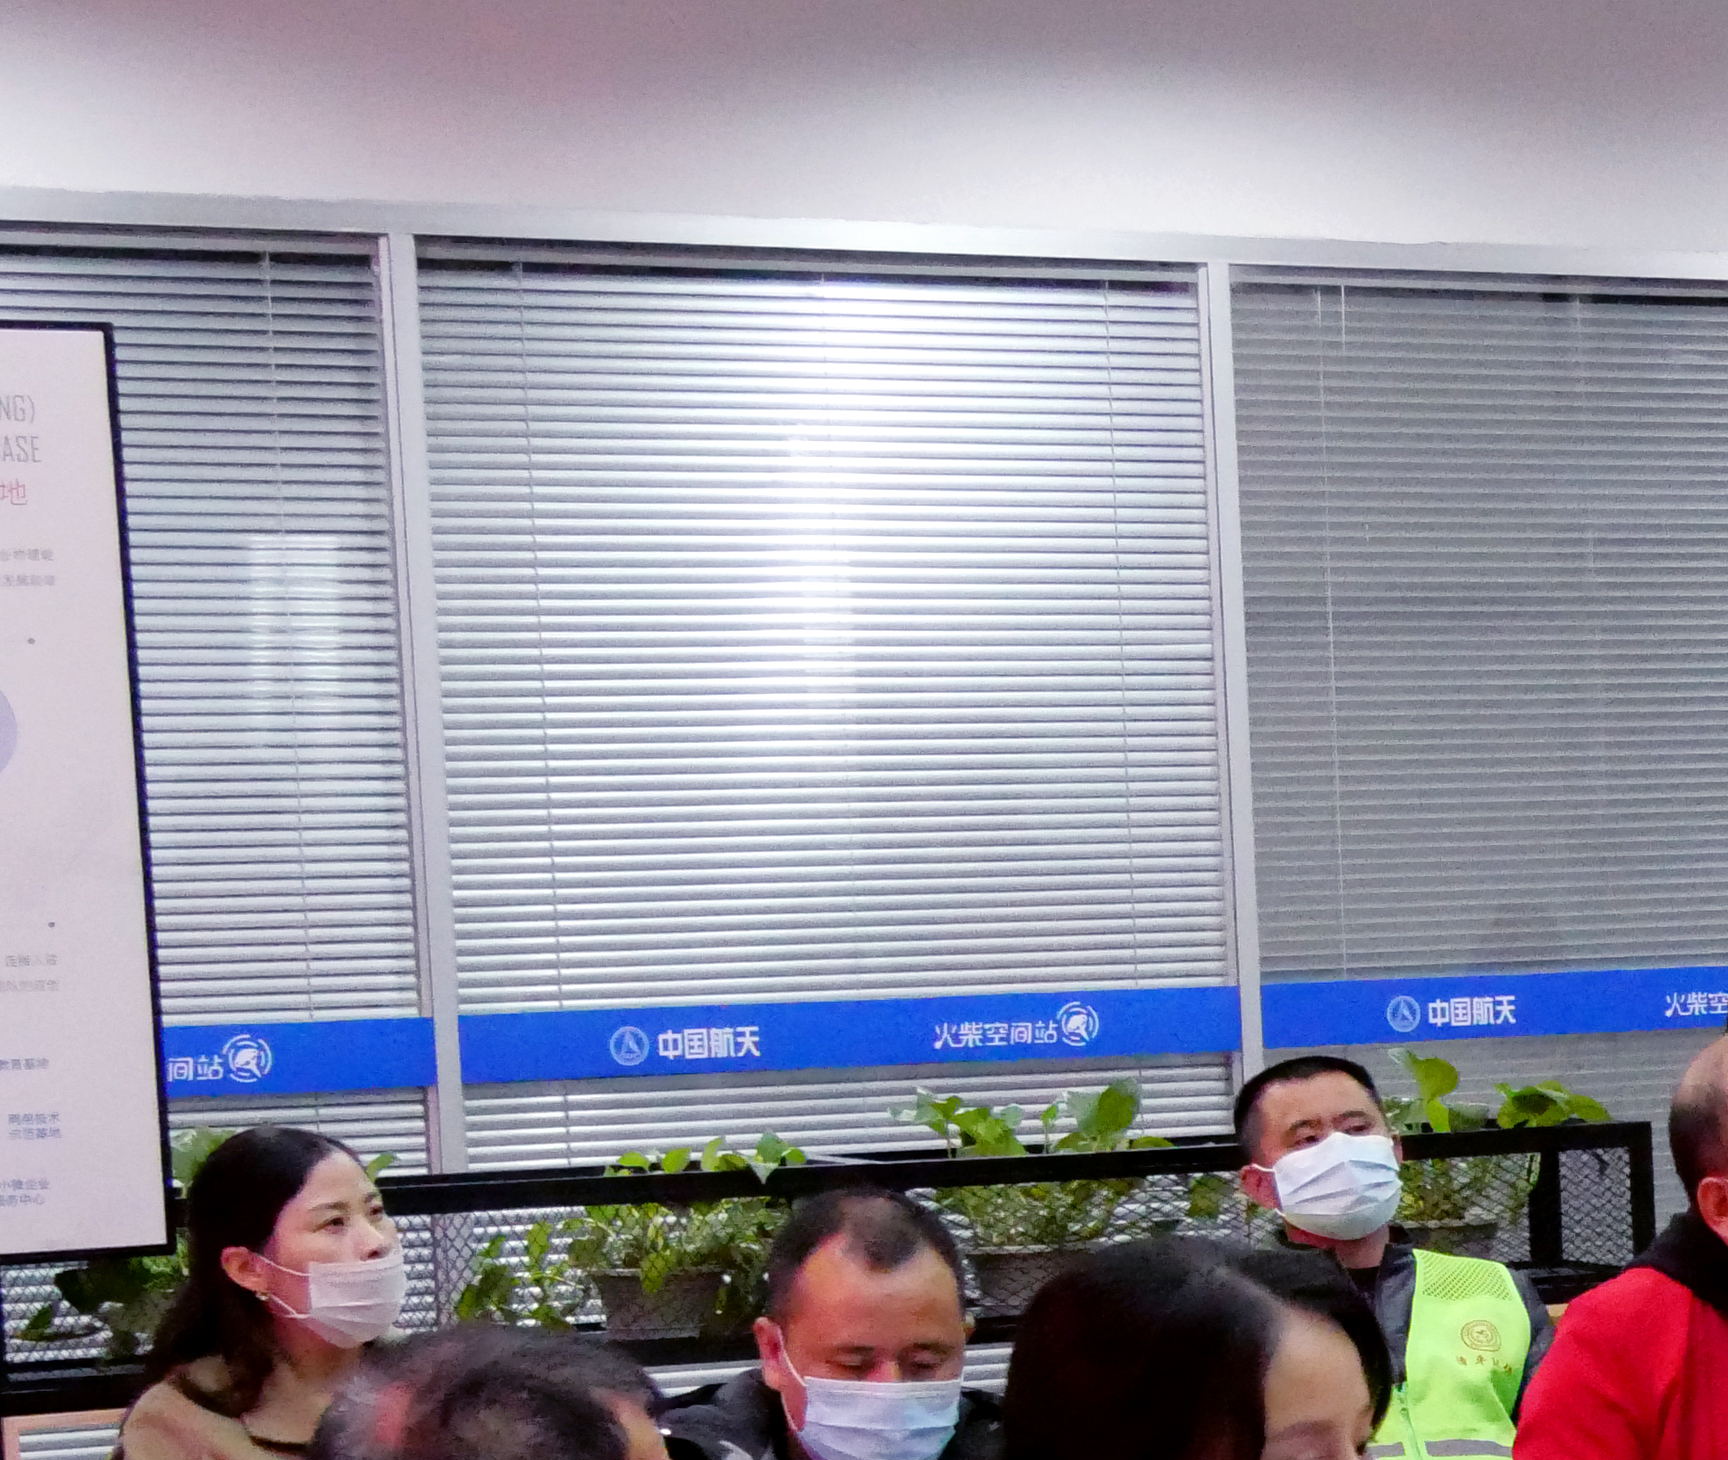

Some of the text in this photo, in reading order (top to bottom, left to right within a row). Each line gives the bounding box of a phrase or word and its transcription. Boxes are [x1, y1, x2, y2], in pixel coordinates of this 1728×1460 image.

[1427, 994, 1517, 1027] 中国航天
[657, 1025, 761, 1060] 中国航天
[932, 1019, 1058, 1050] 火柴空间站
